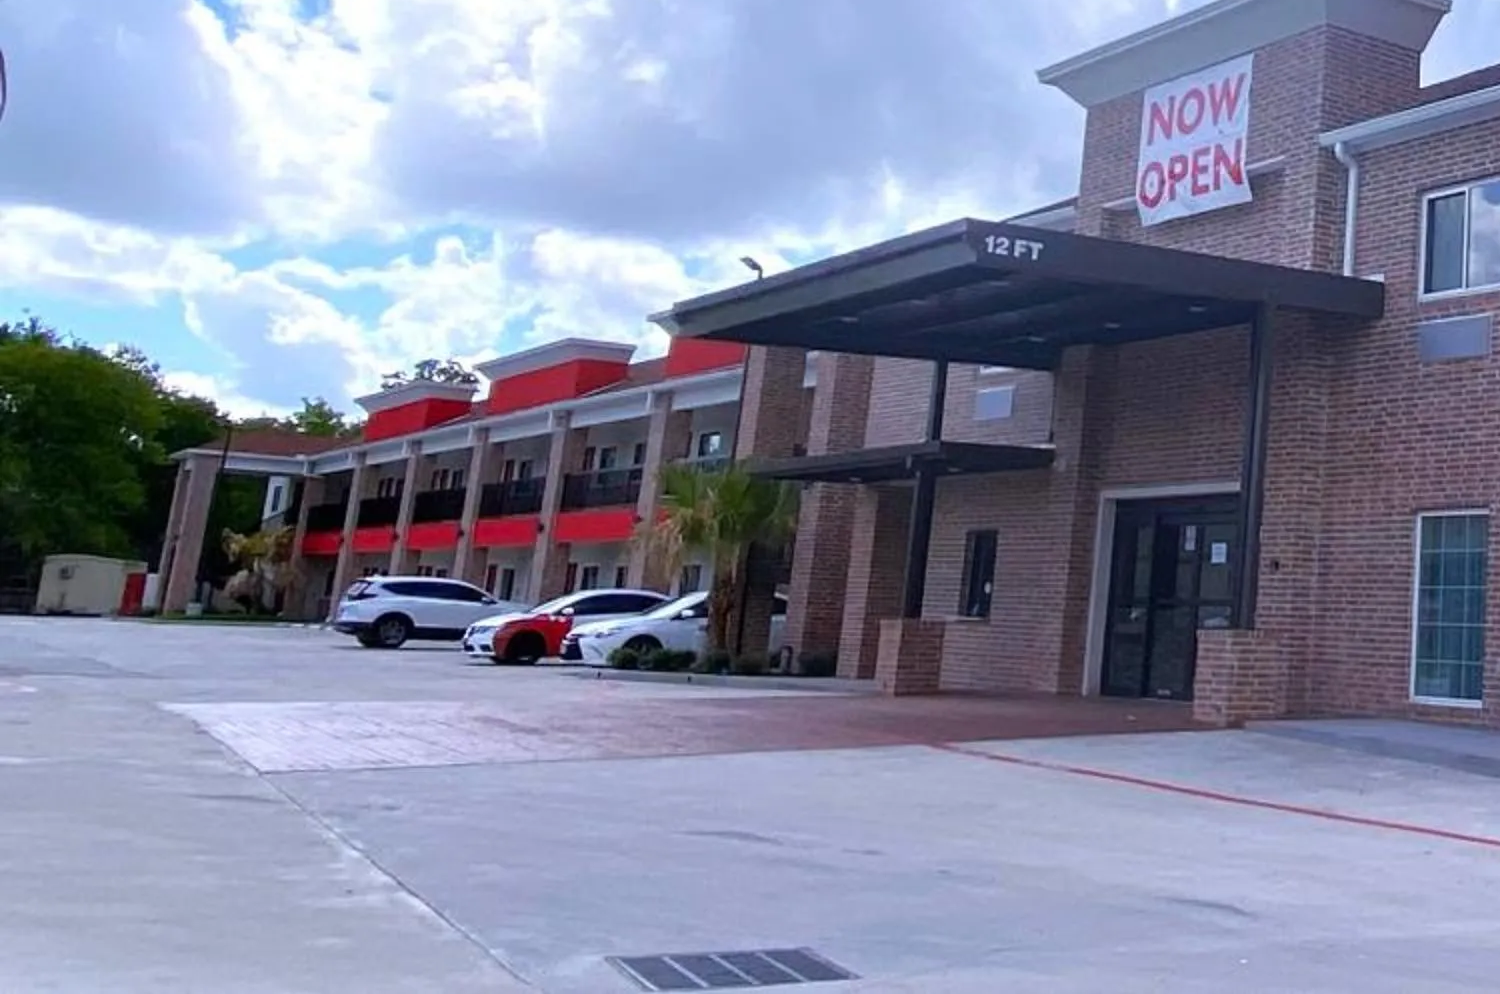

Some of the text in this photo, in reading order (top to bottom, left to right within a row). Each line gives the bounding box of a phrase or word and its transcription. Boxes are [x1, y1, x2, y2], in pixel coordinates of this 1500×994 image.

[1147, 72, 1247, 146] NOW
[1140, 137, 1244, 208] OPEN
[985, 235, 1044, 261] 12 FT
